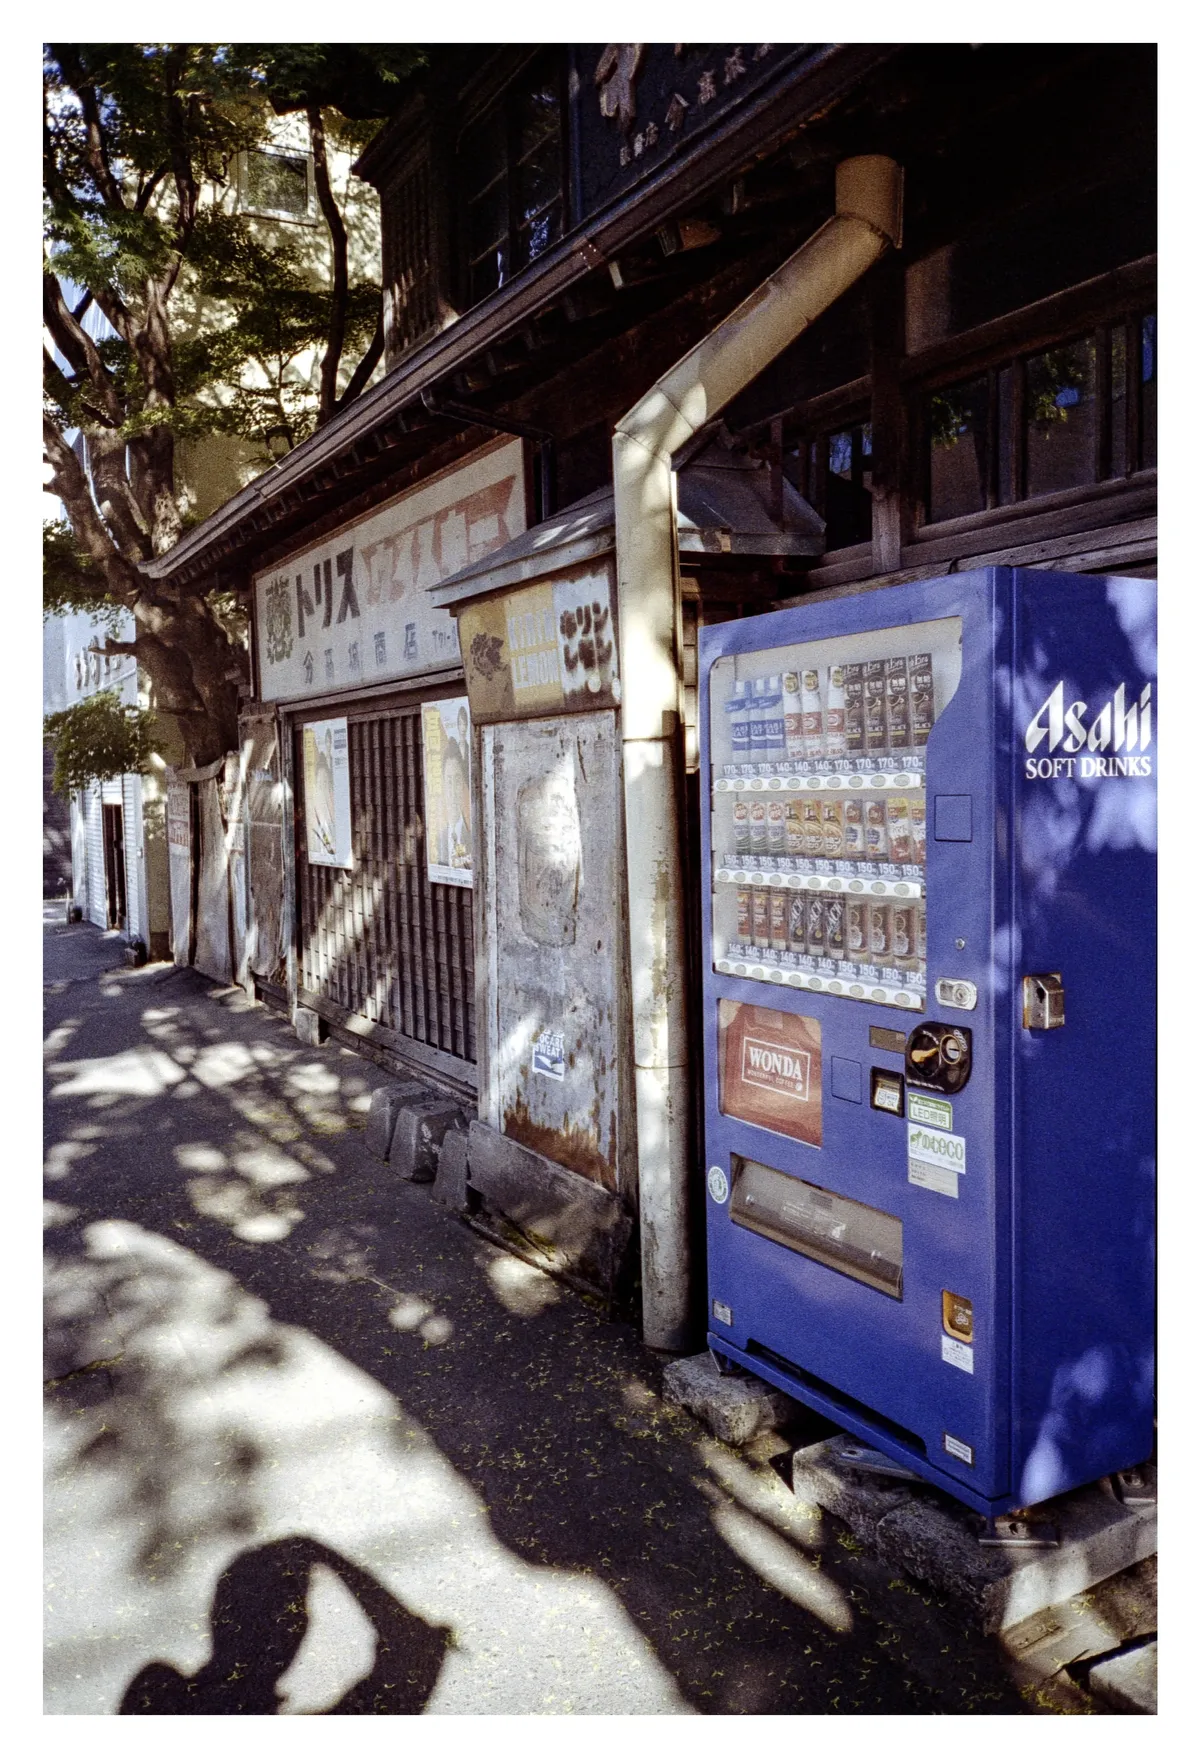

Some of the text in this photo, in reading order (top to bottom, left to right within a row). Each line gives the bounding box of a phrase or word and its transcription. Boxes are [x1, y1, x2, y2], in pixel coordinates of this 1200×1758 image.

[1025, 680, 1151, 753] Asahi
[1025, 756, 1151, 779] SOFT DRINKS
[749, 1046, 803, 1081] WONDA
[912, 1104, 947, 1126] LED照明
